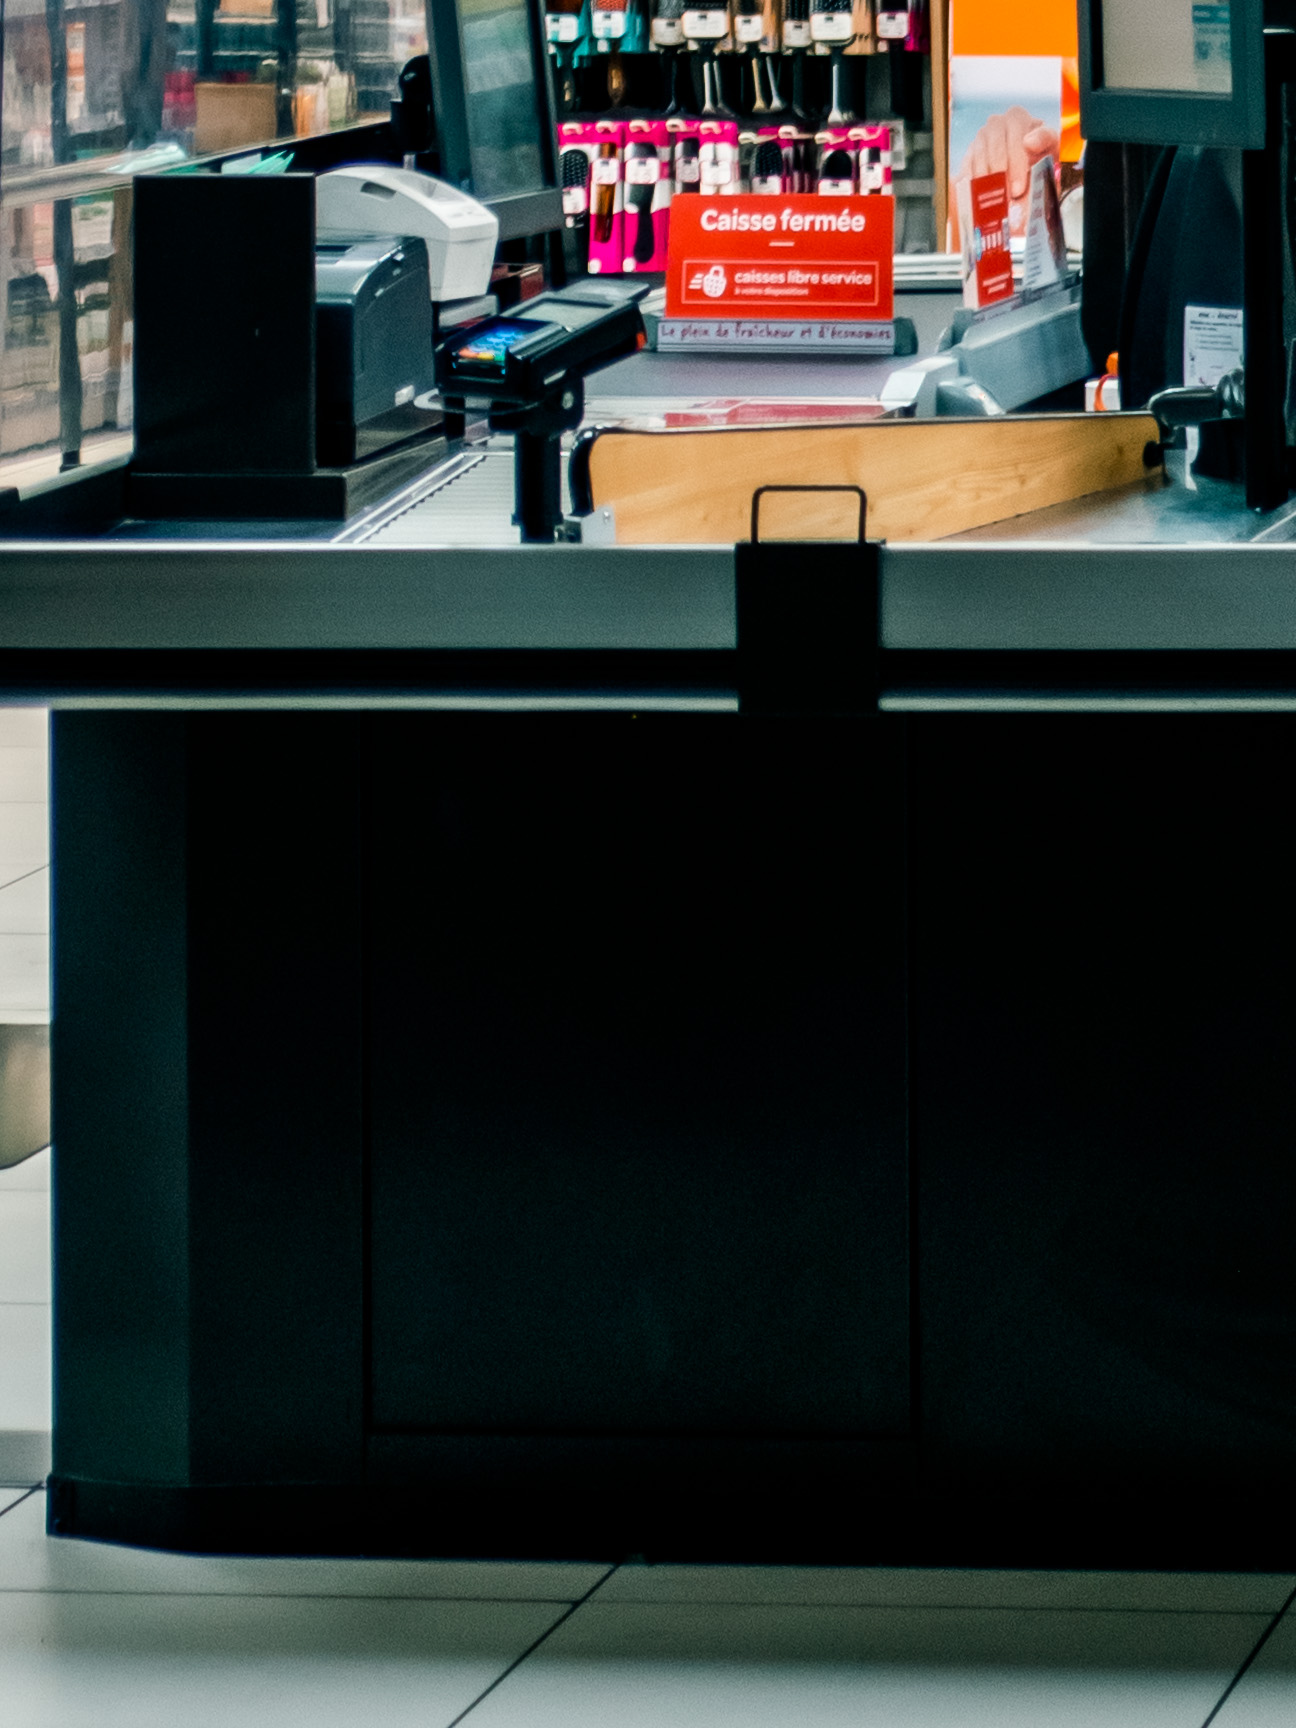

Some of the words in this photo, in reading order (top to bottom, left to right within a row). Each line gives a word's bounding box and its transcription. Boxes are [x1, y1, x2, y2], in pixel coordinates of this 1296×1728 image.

[700, 208, 777, 232] Caisse
[780, 207, 866, 232] fermée
[734, 269, 785, 284] caisses
[787, 269, 820, 284] libre
[821, 270, 873, 285] service
